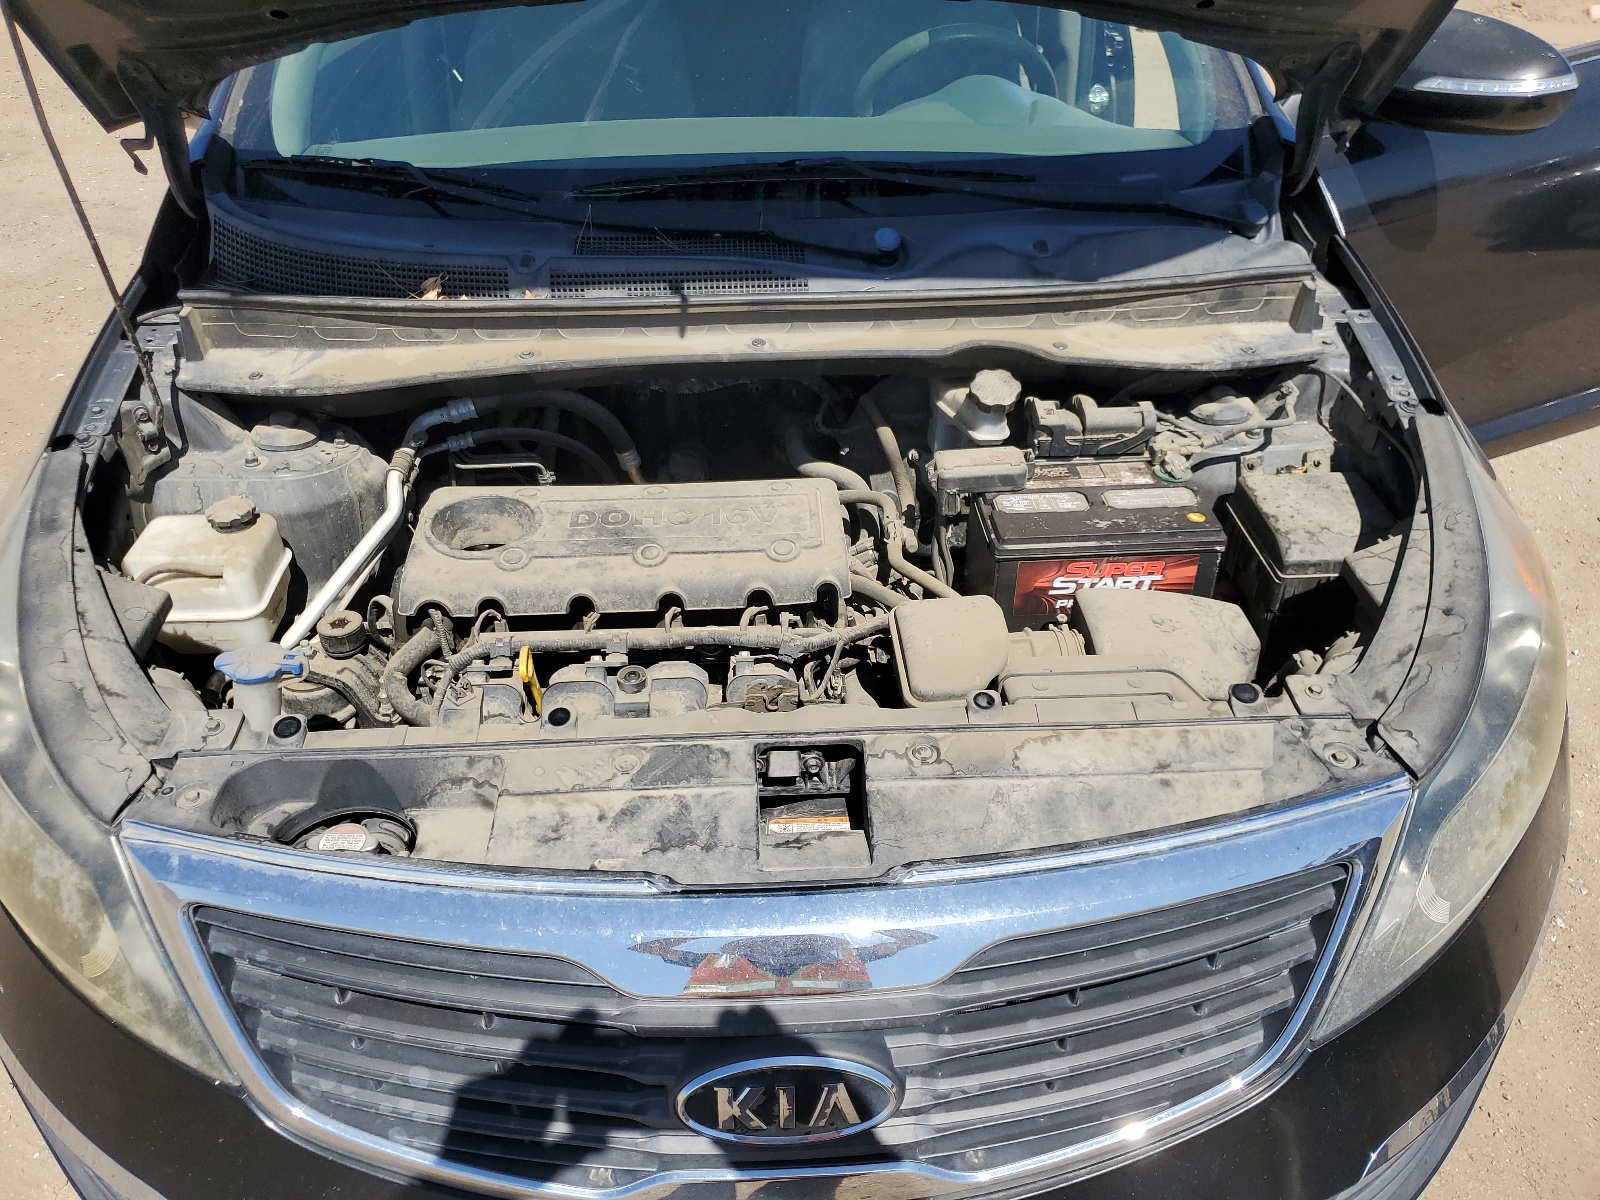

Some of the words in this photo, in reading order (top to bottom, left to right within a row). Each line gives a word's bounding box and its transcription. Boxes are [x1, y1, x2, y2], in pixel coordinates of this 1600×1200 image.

[568, 508, 698, 528] DOHC
[703, 505, 783, 526] 16V
[1063, 561, 1166, 579] SUPER
[1048, 575, 1165, 595] START
[713, 1083, 862, 1130] KIA
